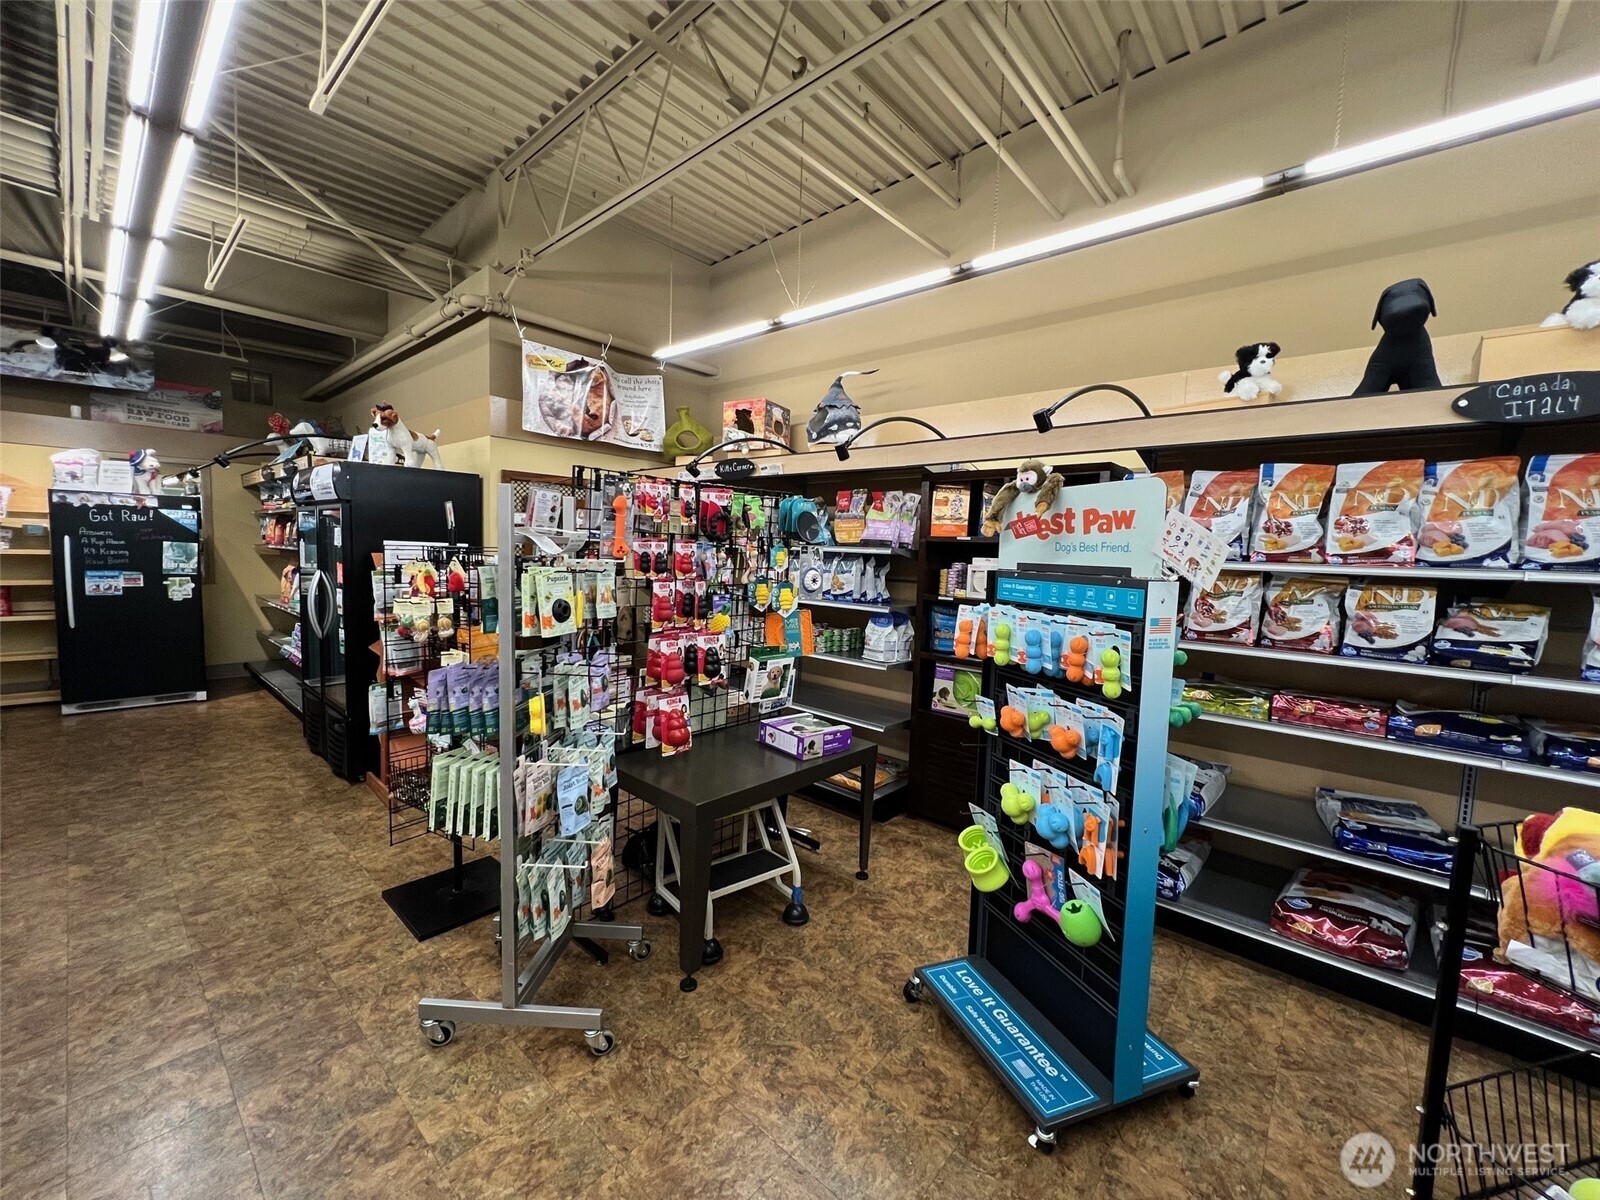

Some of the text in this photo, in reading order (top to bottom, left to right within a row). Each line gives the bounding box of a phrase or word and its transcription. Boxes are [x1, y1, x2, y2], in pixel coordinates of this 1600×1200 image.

[1496, 374, 1570, 398] Canada
[127, 408, 190, 422] RAW FOOD
[732, 462, 750, 472] Corner
[1442, 488, 1500, 511] N&D
[89, 509, 114, 522] Got
[121, 509, 154, 522] Raw!
[1082, 508, 1136, 535] Paw
[1055, 542, 1131, 554] Dog's Best Friend.
[1369, 587, 1427, 604] N&D
[939, 975, 958, 994] Durable
[956, 970, 984, 996] Love
[981, 997, 996, 1007] It
[992, 1009, 1058, 1077] Guarantee
[966, 1005, 1002, 1045] Safe Materials
[1030, 1081, 1050, 1104] THE USA
[1036, 1079, 1051, 1094] MADE
